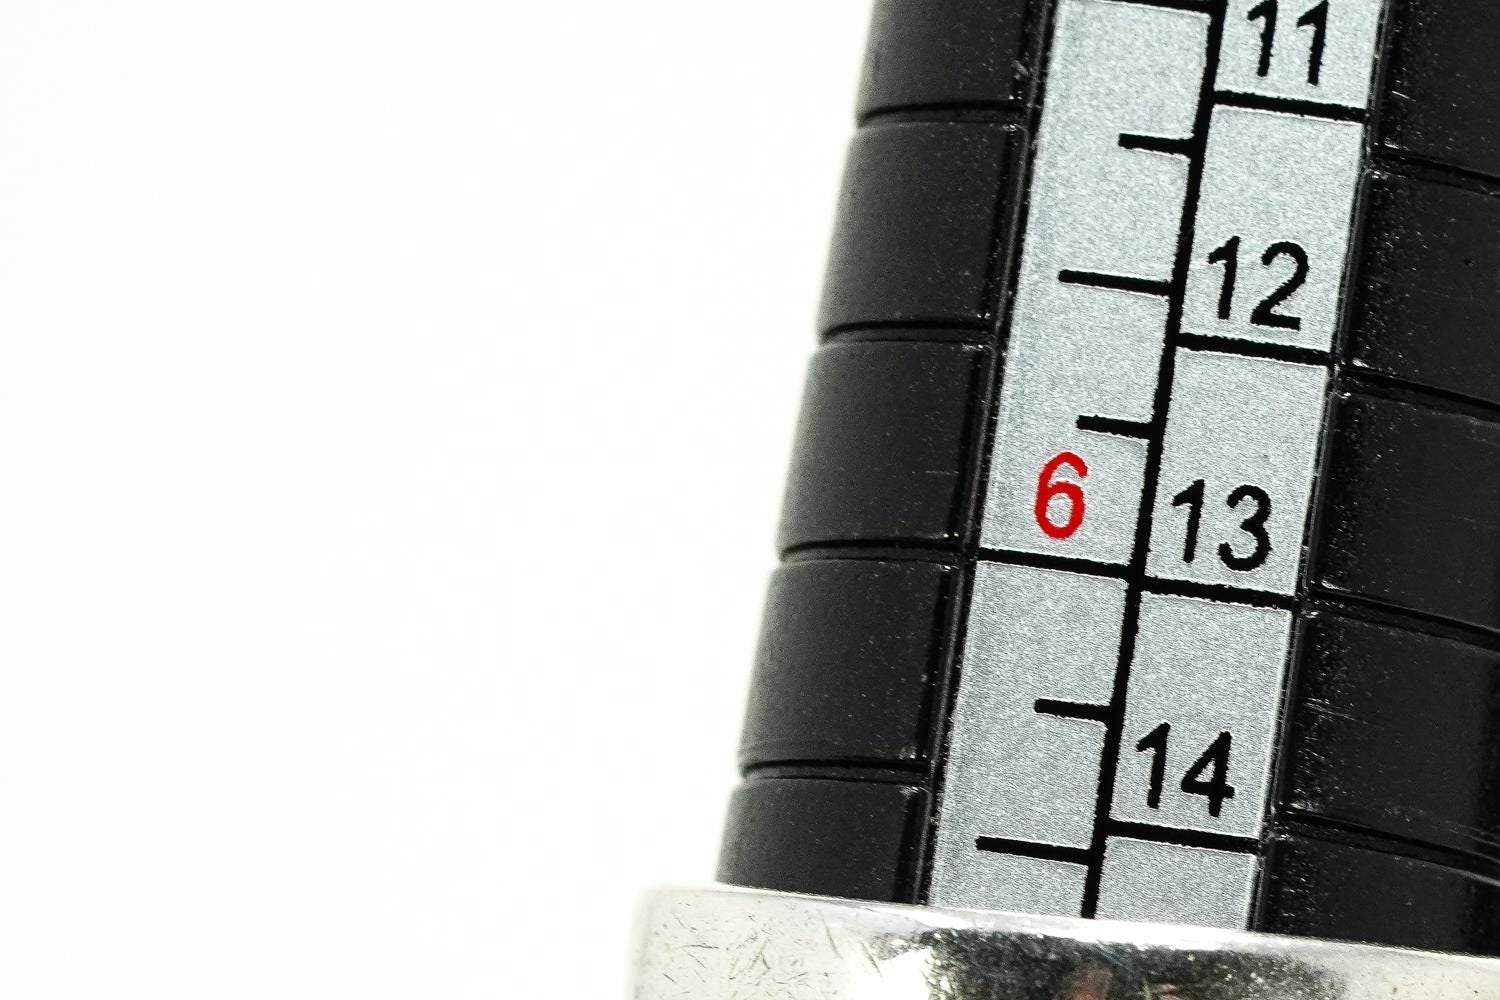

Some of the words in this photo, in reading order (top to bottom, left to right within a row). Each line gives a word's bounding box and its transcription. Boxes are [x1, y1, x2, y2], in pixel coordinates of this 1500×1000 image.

[1247, 0, 1329, 86] 11
[1207, 235, 1310, 331] 12
[1033, 451, 1088, 540] 6
[1170, 478, 1273, 572] 13
[1135, 721, 1236, 818] 14
